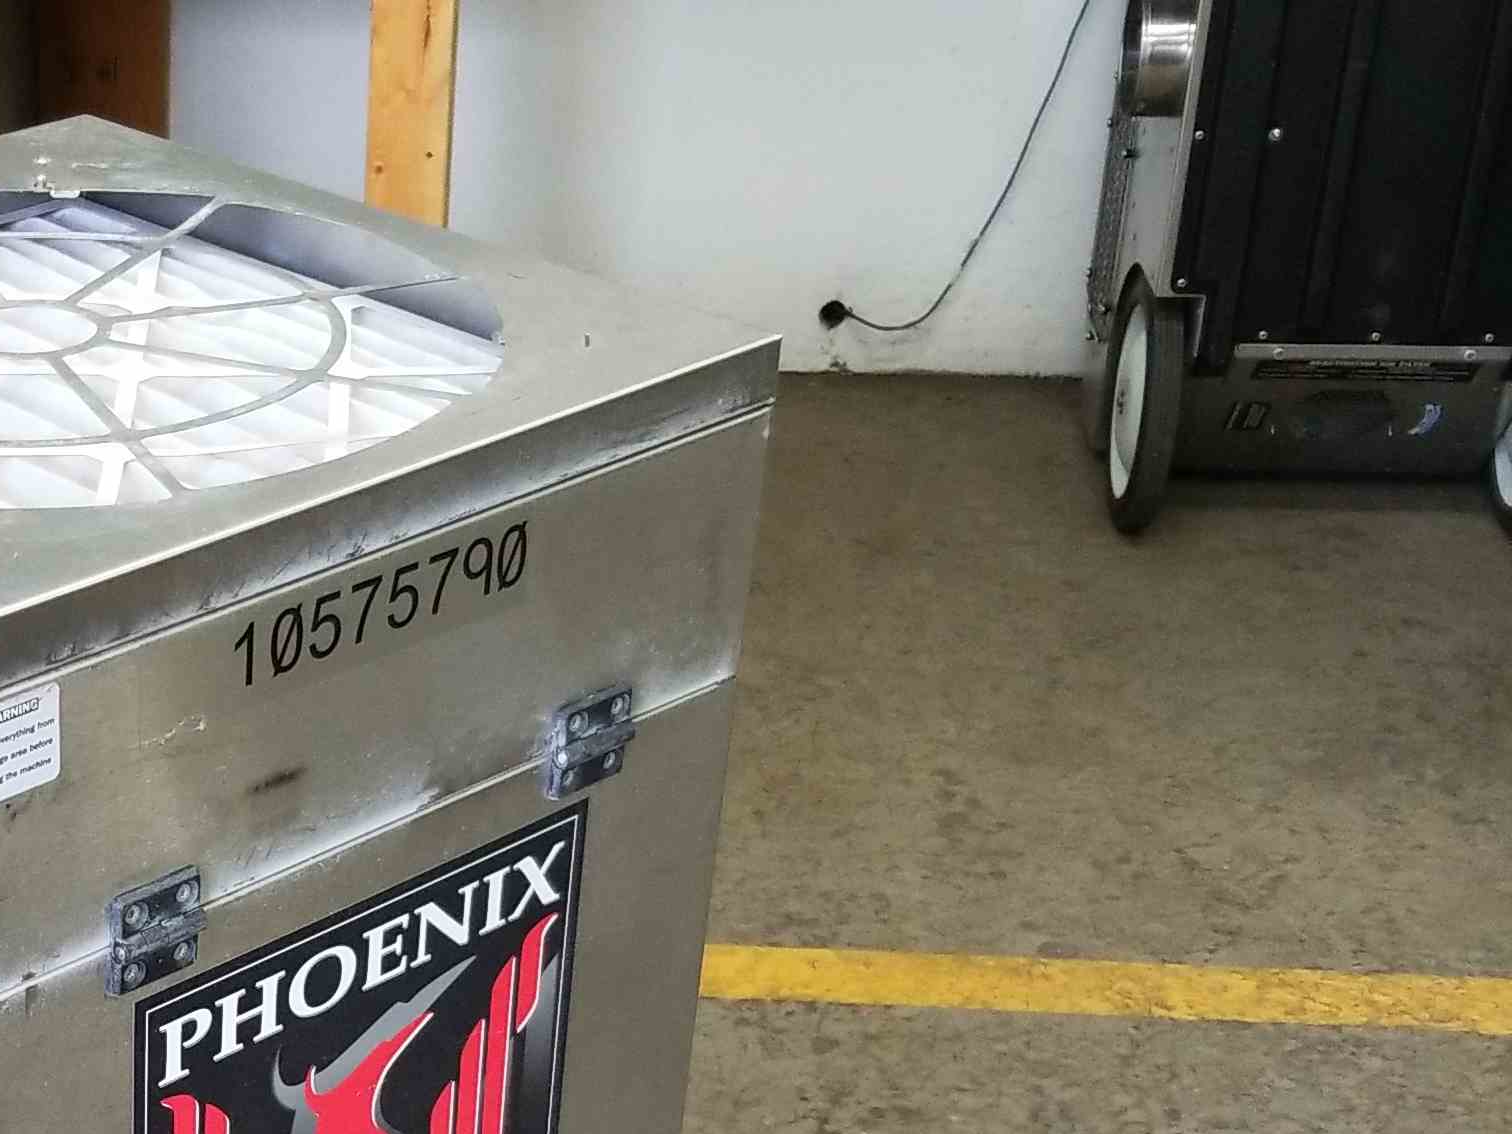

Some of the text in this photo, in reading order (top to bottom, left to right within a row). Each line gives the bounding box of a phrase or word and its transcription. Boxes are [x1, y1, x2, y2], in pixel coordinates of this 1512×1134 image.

[234, 521, 527, 686] 10575790
[38, 718, 55, 731] from
[10, 748, 28, 759] area
[30, 737, 53, 752] before
[6, 770, 18, 780] the
[20, 757, 52, 775] machine
[158, 839, 566, 1088] PHOENIX
